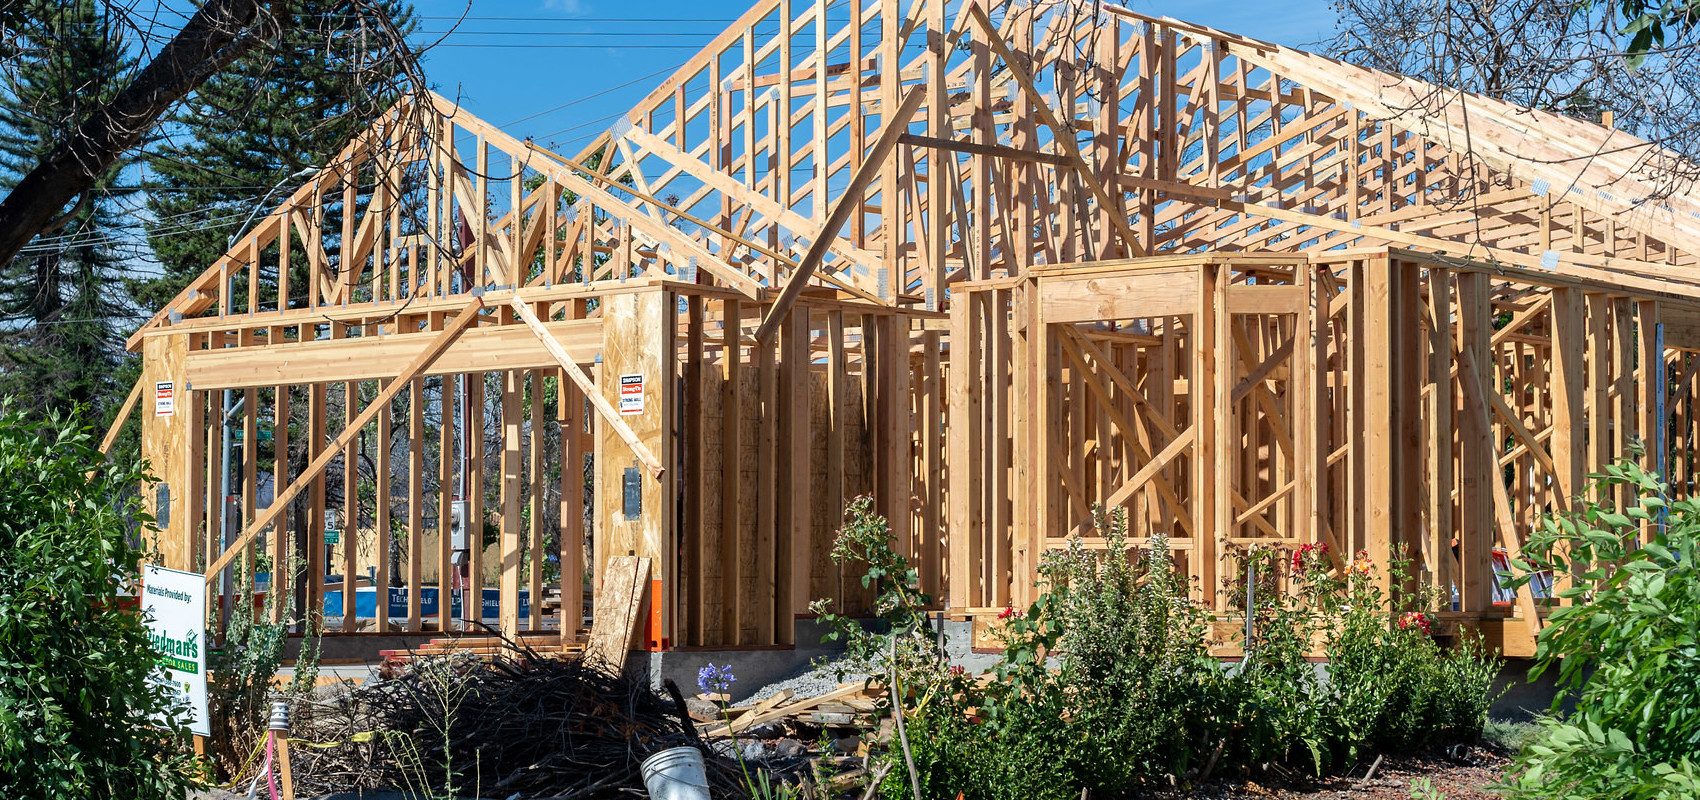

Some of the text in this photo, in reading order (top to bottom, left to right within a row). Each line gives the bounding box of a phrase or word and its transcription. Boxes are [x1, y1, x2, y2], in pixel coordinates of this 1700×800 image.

[147, 584, 192, 604] Materials Provided by:
[177, 661, 195, 672] SALES
